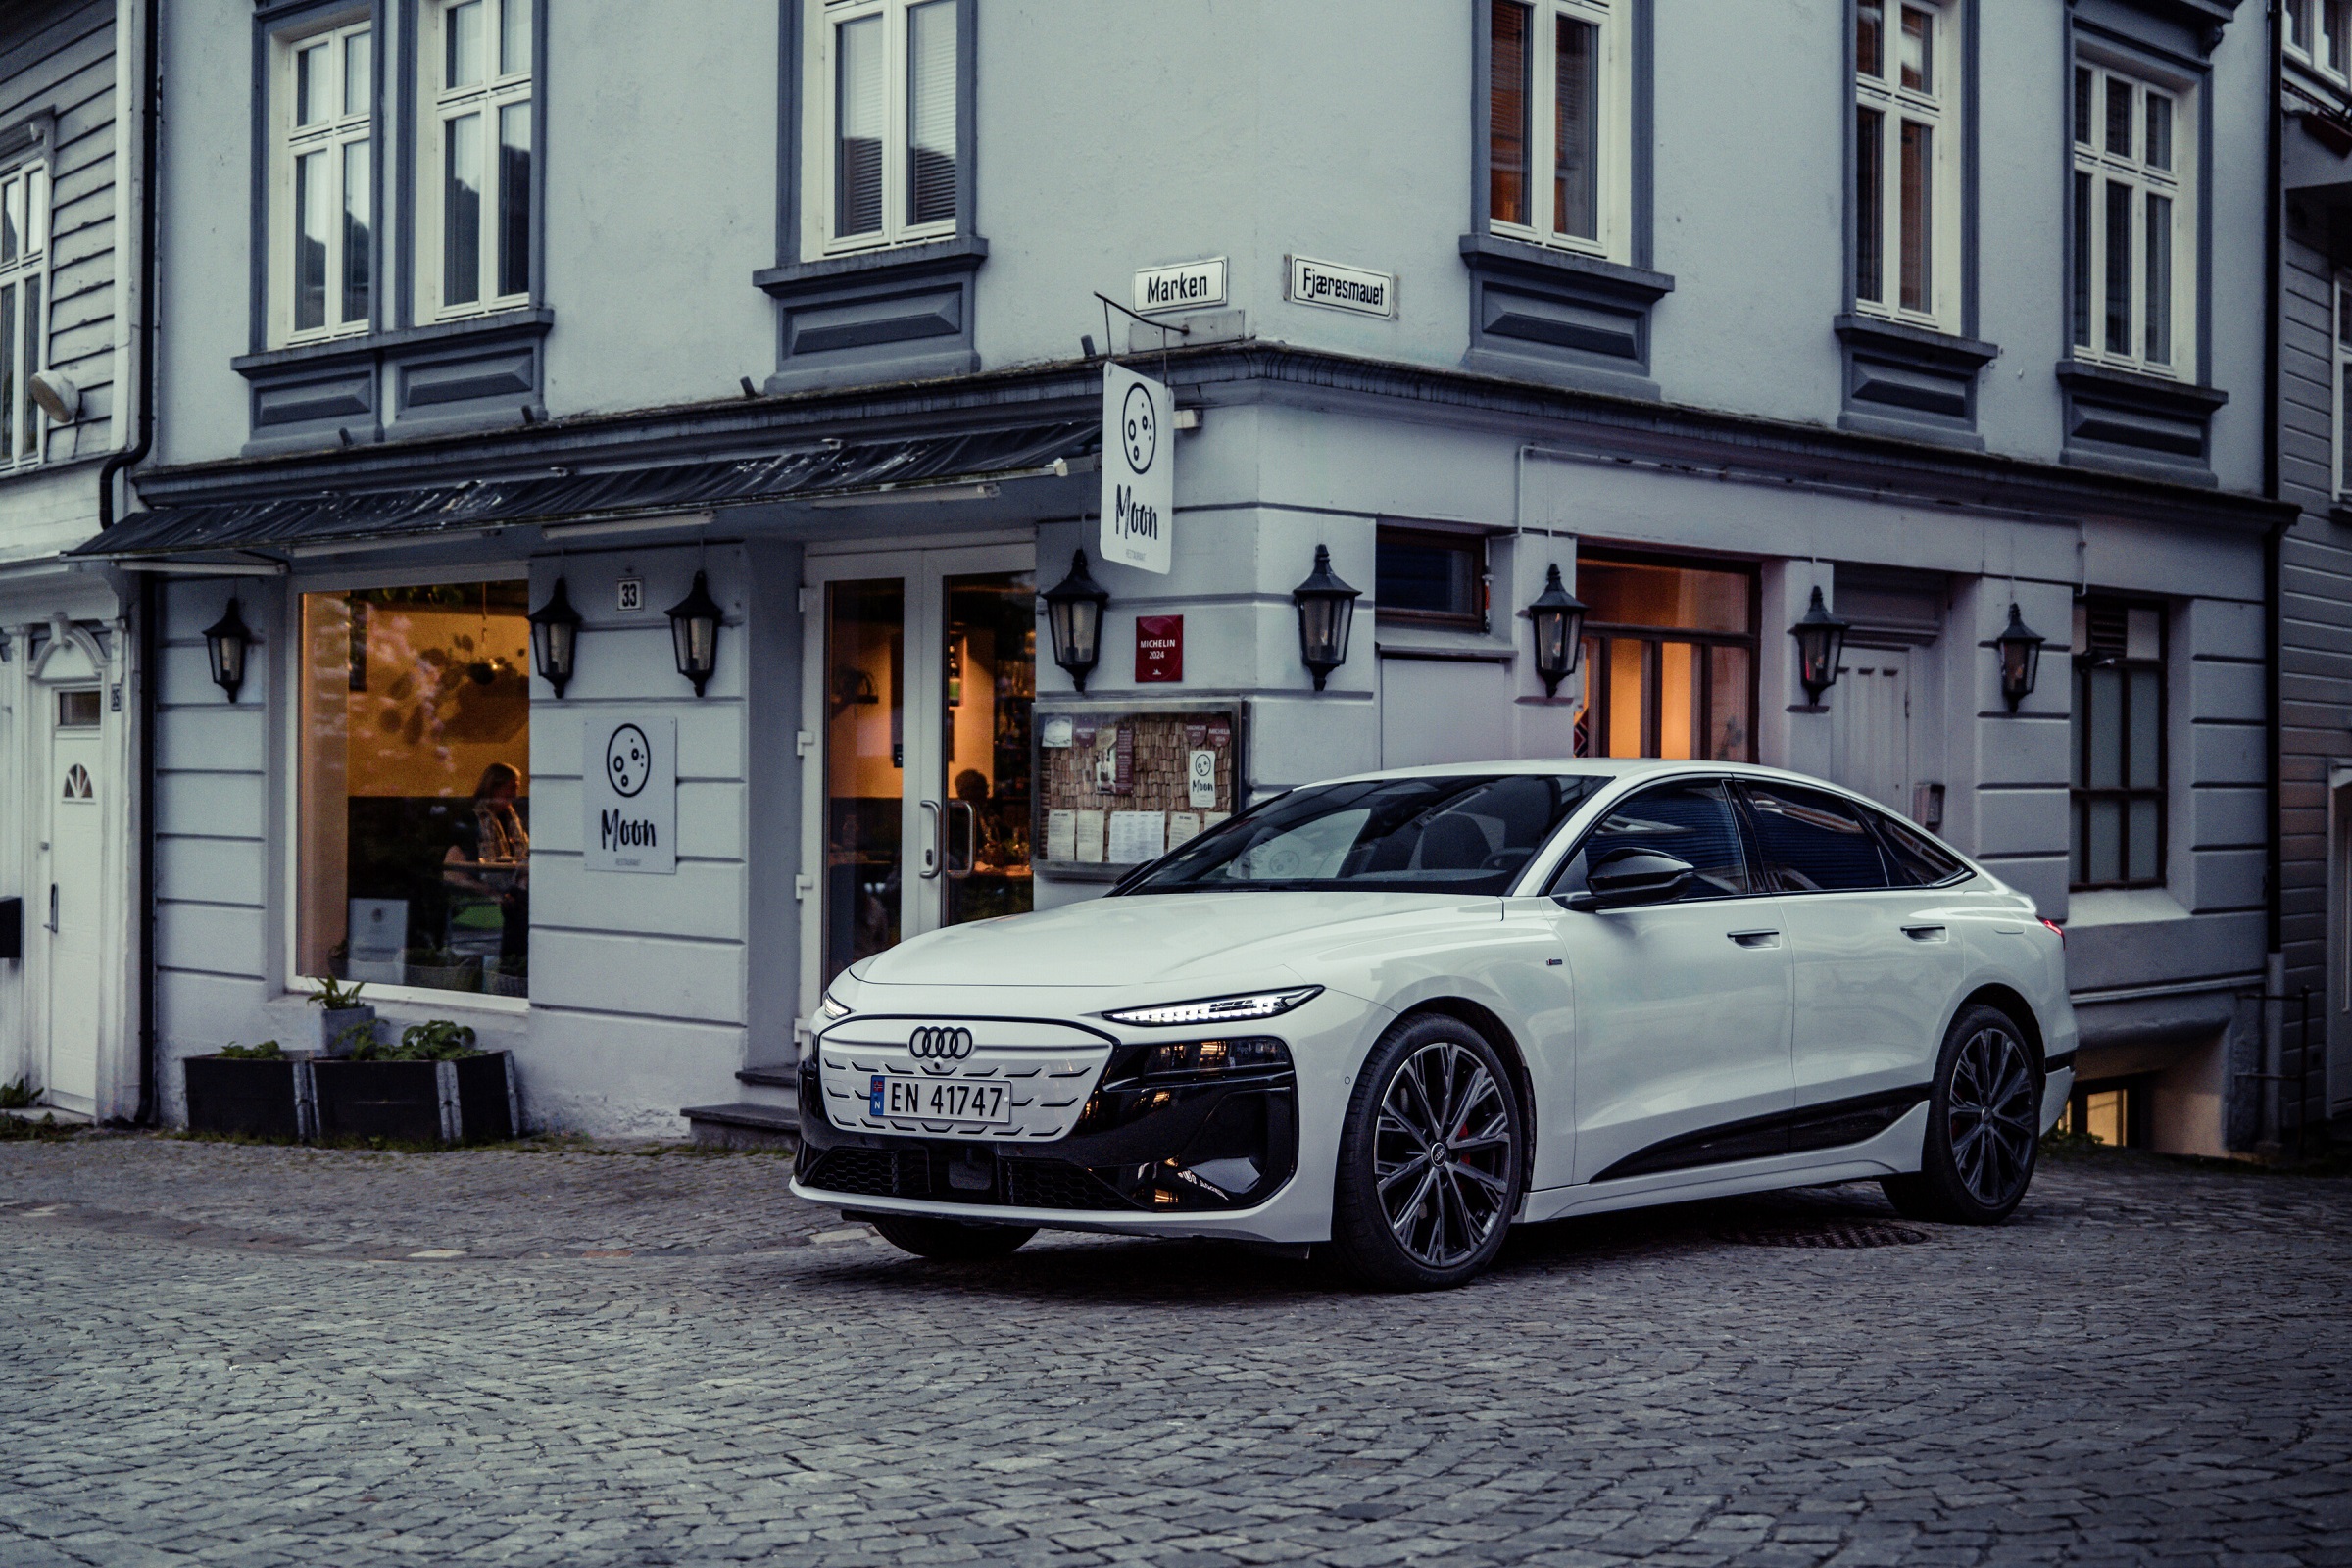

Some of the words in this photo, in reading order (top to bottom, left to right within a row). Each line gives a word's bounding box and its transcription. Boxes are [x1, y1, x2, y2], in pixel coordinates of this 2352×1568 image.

[1147, 271, 1208, 304] Marken
[1302, 267, 1385, 307] Fjæresmauet
[1115, 483, 1158, 541] Moon
[621, 583, 638, 608] 33
[1140, 639, 1176, 649] MICHELIN
[1149, 650, 1165, 660] 2024
[1192, 779, 1214, 793] Moon
[601, 808, 657, 853] Moon
[874, 1101, 881, 1109] N
[890, 1082, 919, 1113] EN
[930, 1084, 1003, 1117] 41747
